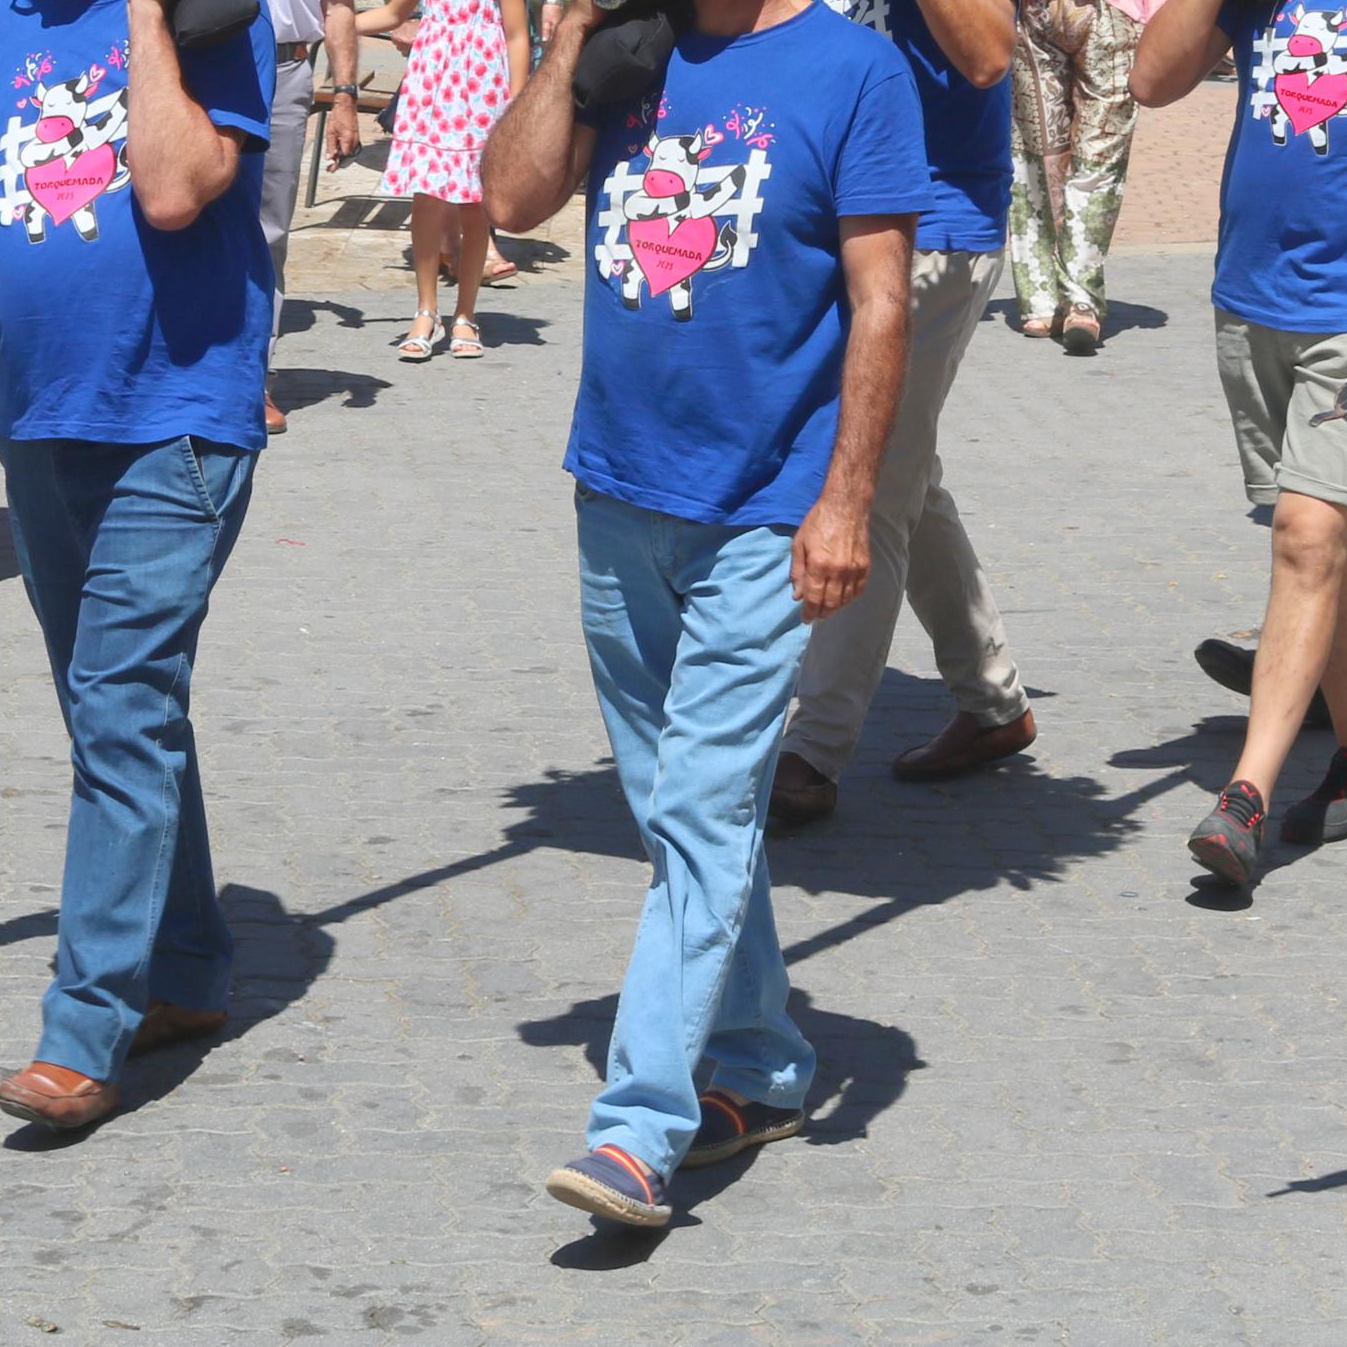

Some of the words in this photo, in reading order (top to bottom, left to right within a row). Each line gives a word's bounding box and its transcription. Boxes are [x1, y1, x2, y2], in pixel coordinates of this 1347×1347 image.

[1281, 88, 1338, 108] TORQUEMADA
[34, 176, 104, 190] TORQUEMADA
[636, 239, 702, 261] TORQUEMADA
